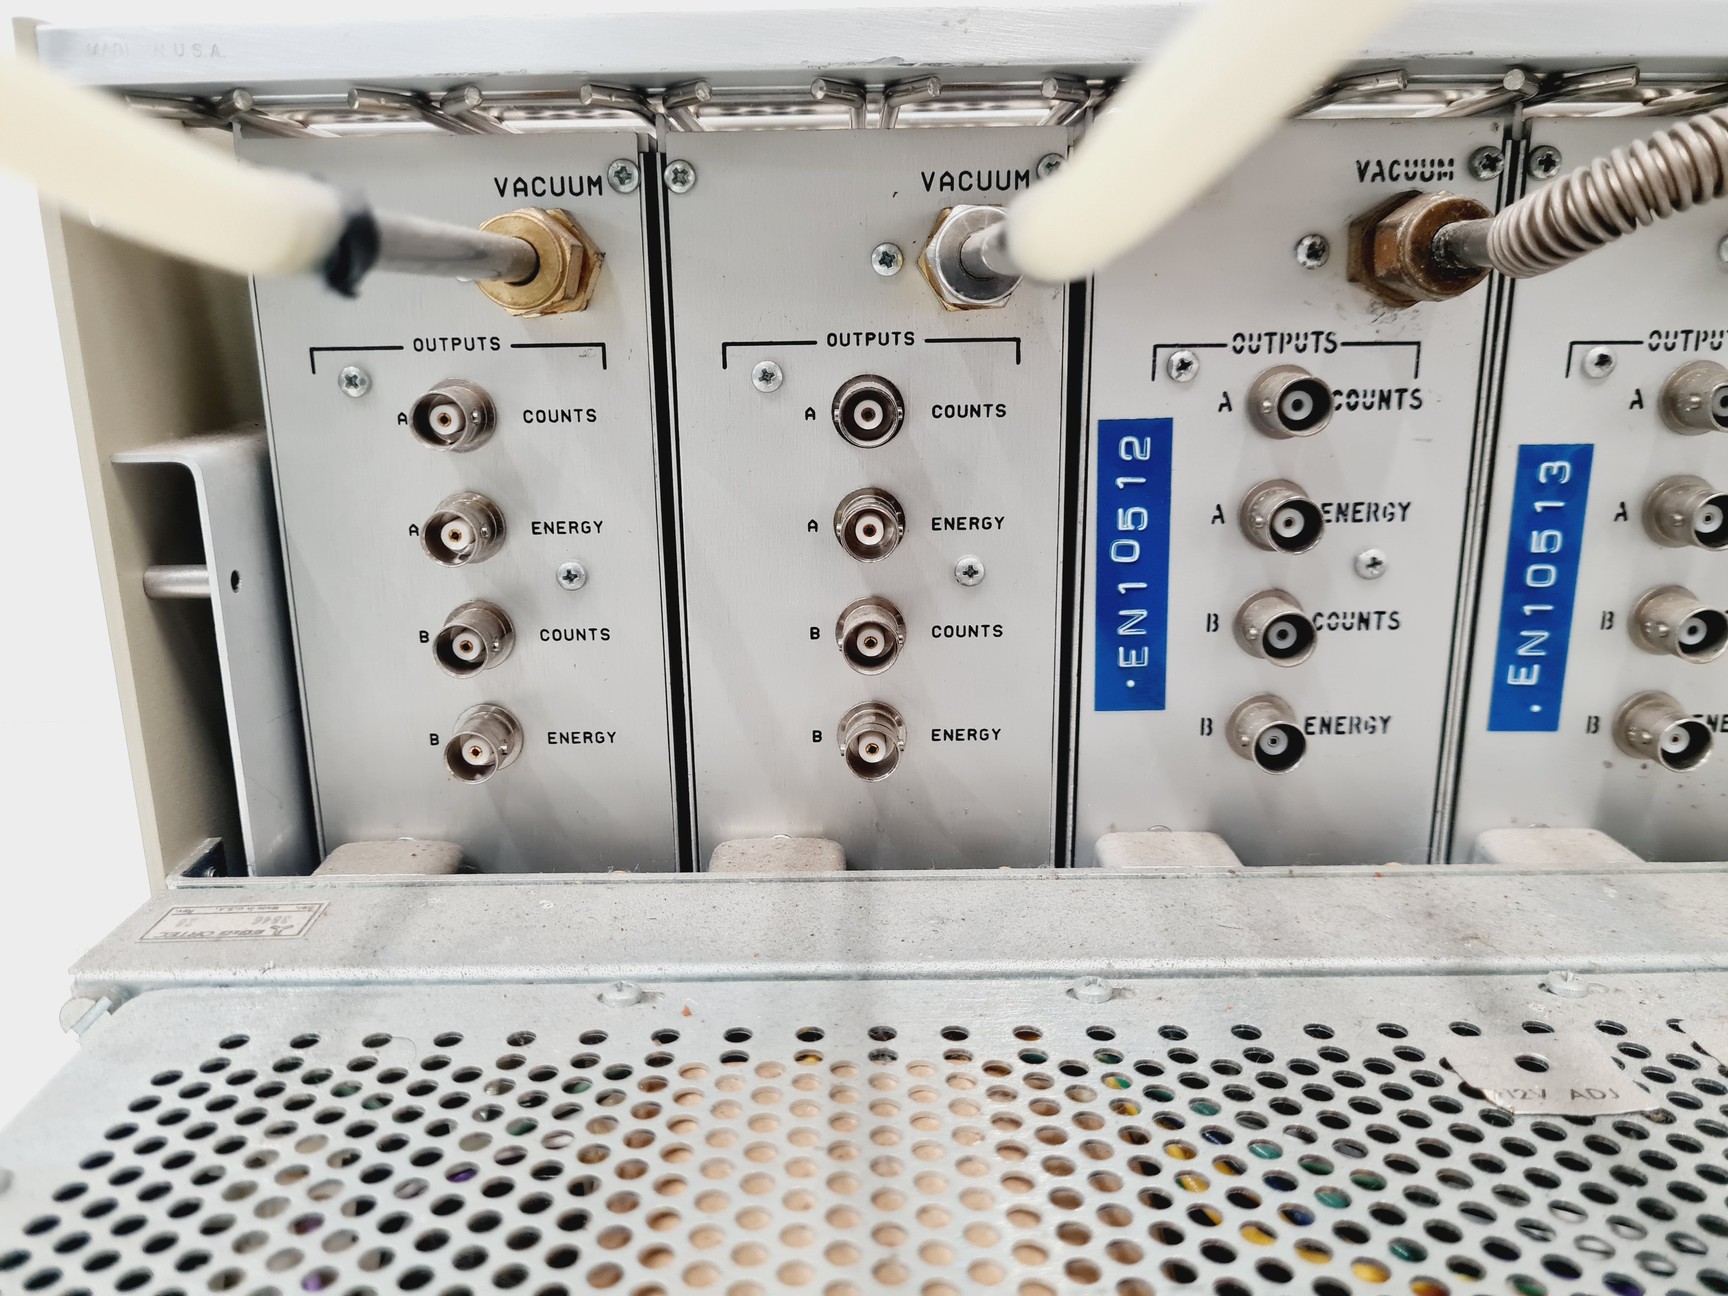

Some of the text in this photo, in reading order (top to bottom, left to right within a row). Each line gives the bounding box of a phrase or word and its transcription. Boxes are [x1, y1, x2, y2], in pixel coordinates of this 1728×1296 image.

[920, 168, 1031, 193] VACUUM
[1355, 157, 1455, 184] VACUUM
[493, 174, 603, 198] VACUUM
[412, 336, 501, 353] OUTPUTS
[826, 330, 915, 348] OUTPUTS
[1231, 330, 1338, 355] OUTPUTS
[1647, 329, 1728, 352] OUTPU
[1217, 388, 1423, 413] A COUNTS
[1628, 388, 1645, 410] A
[397, 408, 597, 426] A COUNTS
[804, 403, 1007, 421] A COUNTS
[1211, 501, 1411, 525] A ENERGY
[1613, 501, 1629, 522] A
[408, 520, 603, 537] A ENERGY
[807, 516, 1005, 533] A ENERGY
[1206, 610, 1401, 633] B COUNTS
[1600, 610, 1615, 631] B
[419, 627, 611, 644] B COUNTS
[809, 624, 1004, 641] B COUNTS
[1200, 715, 1391, 737] B ENERGY
[1586, 715, 1601, 735] B
[429, 731, 617, 746] B ENERGY
[812, 728, 1002, 743] B ENERGY
[1570, 1087, 1621, 1101] ADJ
